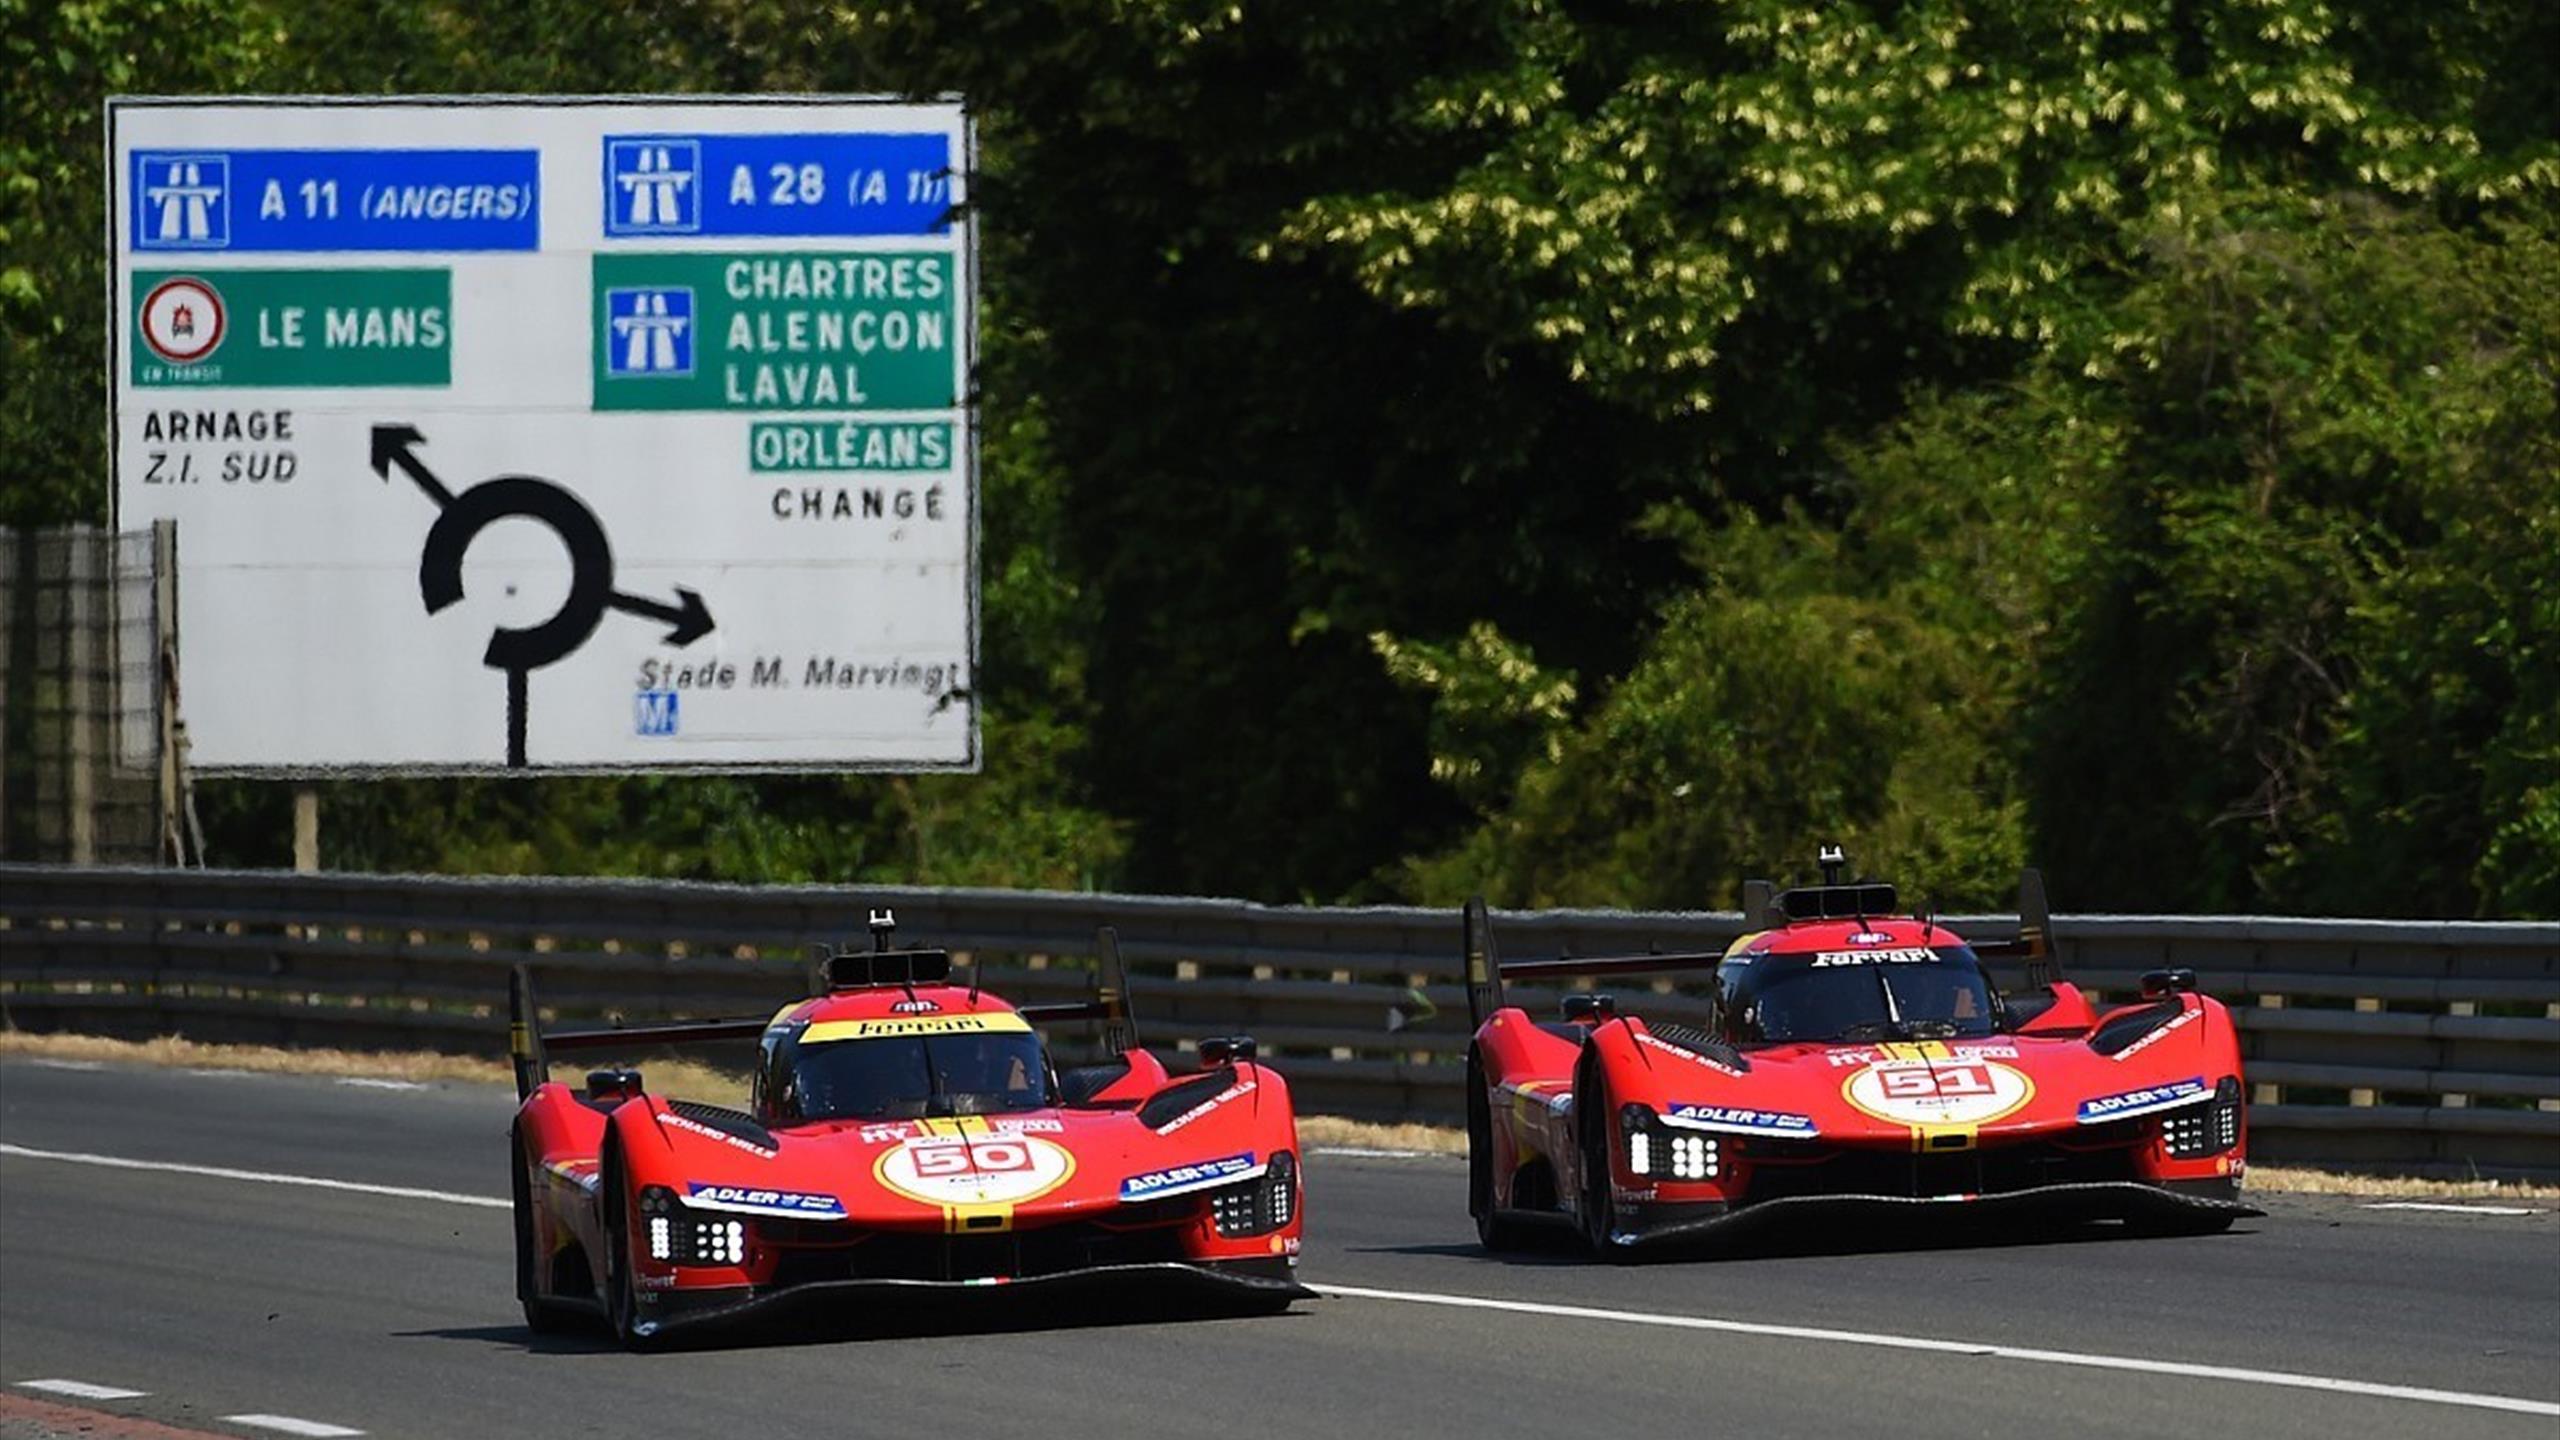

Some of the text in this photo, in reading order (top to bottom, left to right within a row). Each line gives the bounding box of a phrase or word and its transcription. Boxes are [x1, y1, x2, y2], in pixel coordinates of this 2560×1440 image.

[261, 179, 531, 221] A 11 (ANGERS)
[729, 164, 756, 206] A
[769, 163, 825, 205] 28
[849, 168, 887, 206] (A
[725, 259, 943, 300] CHARTRES
[259, 306, 446, 347] LE MANS
[726, 311, 944, 356] ALENÇON
[726, 364, 867, 404] LAVAL
[143, 410, 294, 442] ARNAGE
[755, 421, 946, 468] ORLÉANS
[144, 453, 297, 484] Z.I. SUD
[771, 482, 944, 520] CHANGÉ
[636, 656, 737, 690] Stade
[1811, 947, 1941, 967] Ferrari
[859, 1016, 985, 1035] Ferrari
[1827, 1052, 1874, 1067] HY
[1885, 1067, 1992, 1096] 51
[1675, 1106, 1756, 1123] ADLER
[2087, 1091, 2160, 1114] ADLER
[860, 1127, 908, 1143] HY
[915, 1144, 1027, 1175] 50
[1128, 1167, 1203, 1193] ADLER
[695, 1187, 780, 1205] ADLER
